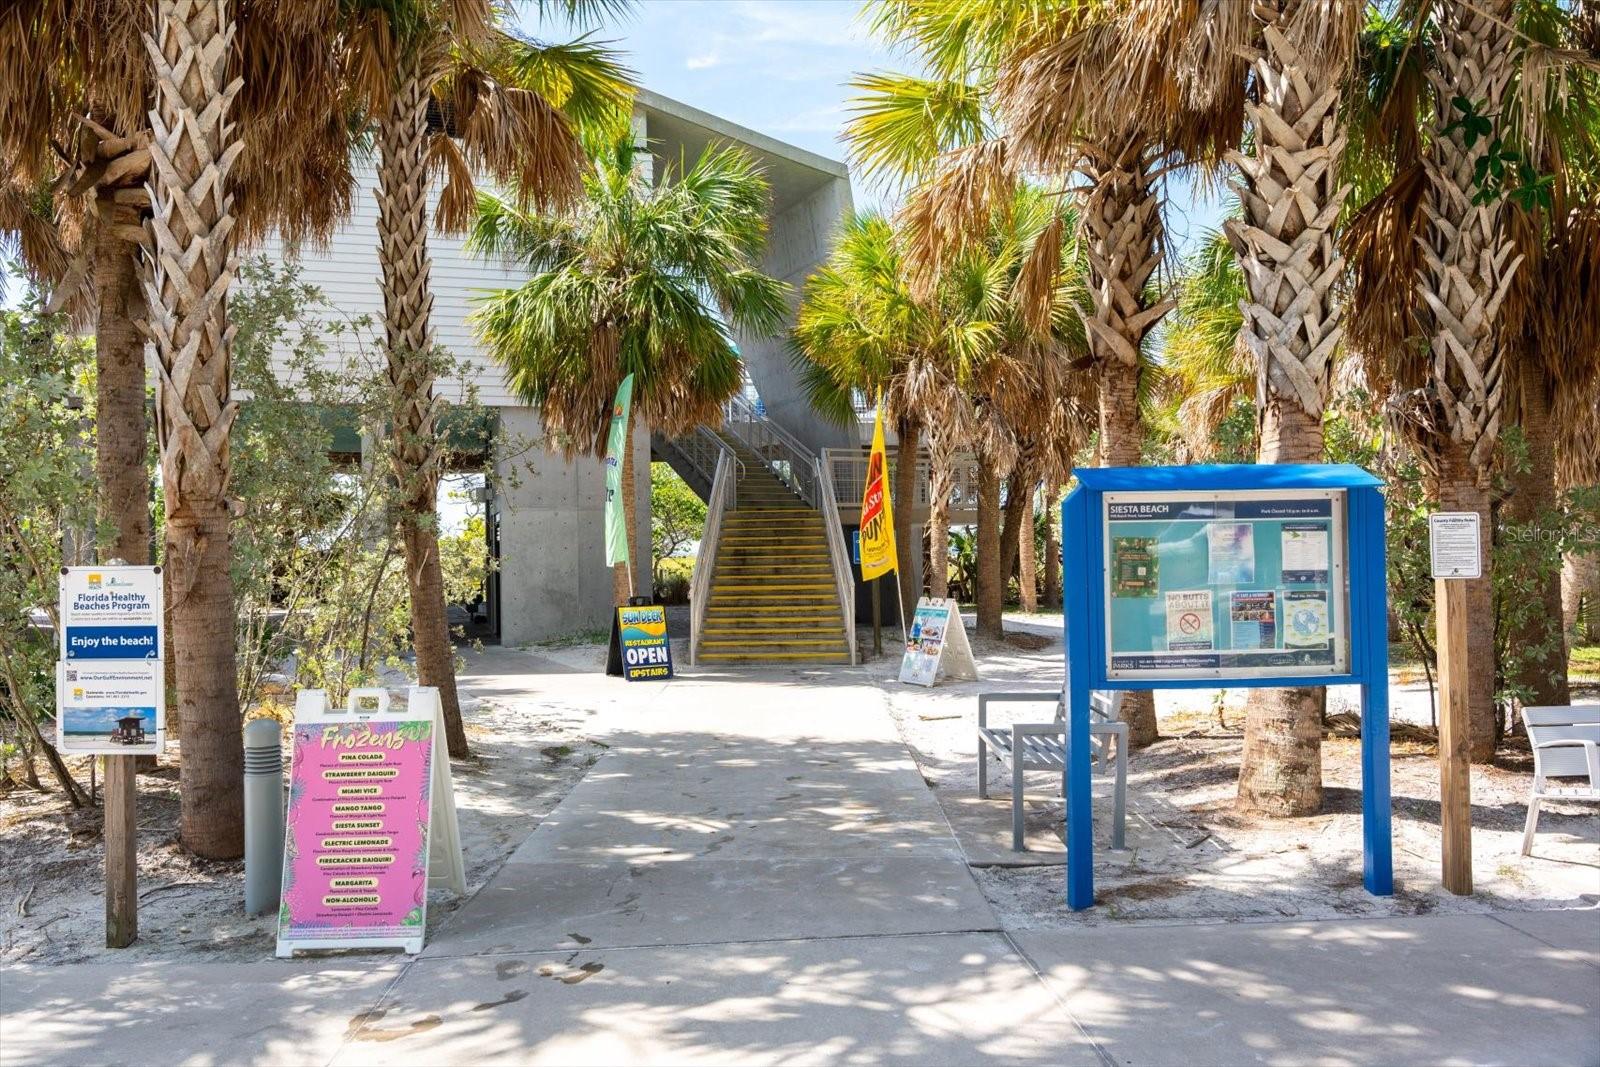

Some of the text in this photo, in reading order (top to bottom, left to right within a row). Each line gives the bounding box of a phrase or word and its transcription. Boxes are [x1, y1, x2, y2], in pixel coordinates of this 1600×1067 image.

[1110, 504, 1169, 514] SIESTA BEACH
[78, 592, 146, 602] Florida Healthy
[73, 602, 150, 611] Beaches Program
[623, 610, 663, 624] SUN DECK
[71, 636, 154, 648] Enjoy the beach!
[626, 646, 668, 664] OPEN
[630, 668, 668, 678] UPSTAIRS
[321, 726, 405, 750] Frozens
